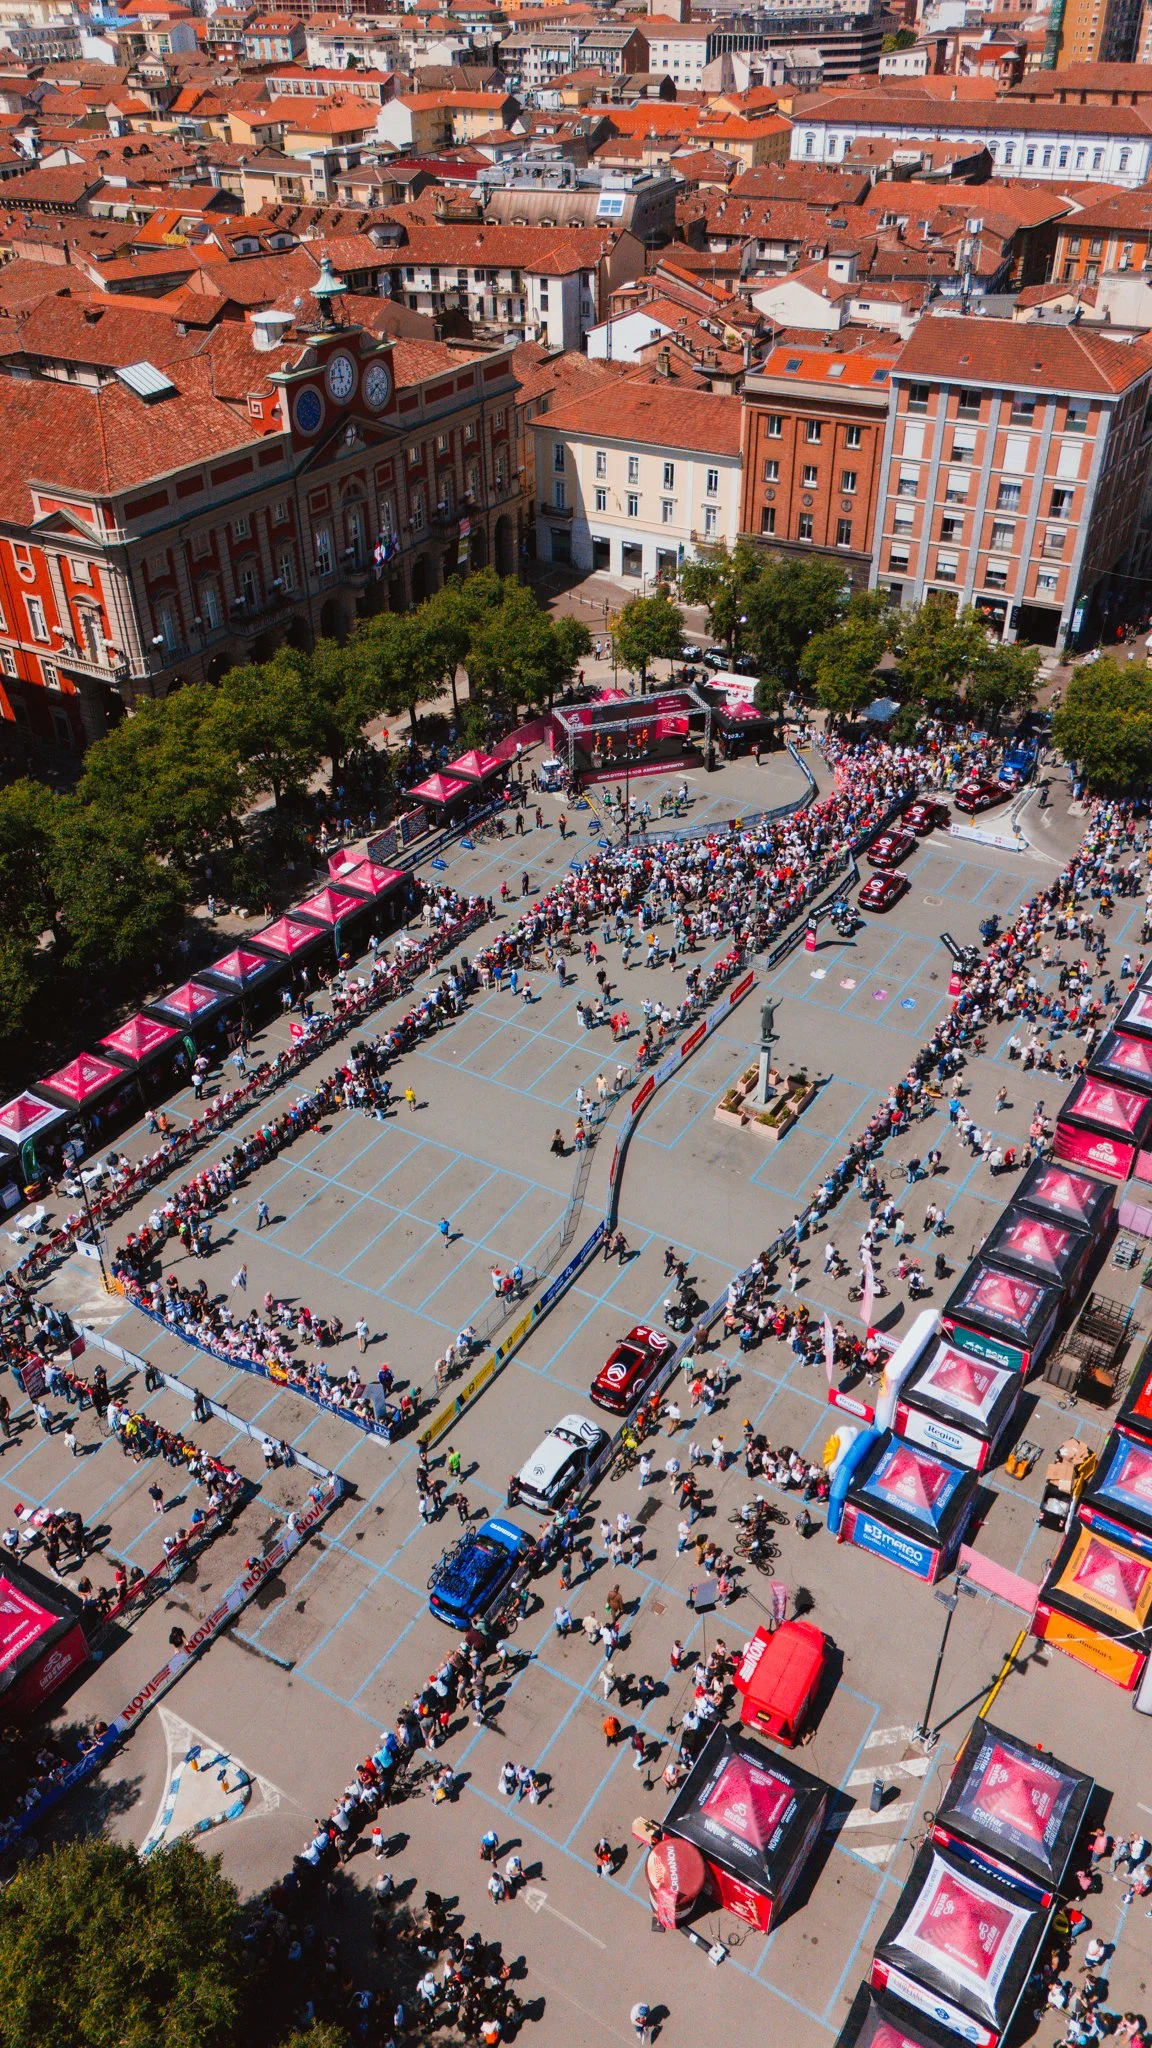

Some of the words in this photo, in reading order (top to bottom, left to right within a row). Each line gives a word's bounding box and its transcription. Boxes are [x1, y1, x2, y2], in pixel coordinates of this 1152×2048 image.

[610, 770, 632, 780] D'ITALA
[928, 1425, 960, 1445] Regina
[296, 1503, 325, 1536] NOVI
[242, 1558, 272, 1593] NOVI
[1082, 1592, 1113, 1612] Continental
[3, 1619, 30, 1644] #giroditalia
[184, 1621, 216, 1655] NOVI
[746, 1636, 768, 1666] NOVI
[51, 1653, 72, 1676] d'Italia
[122, 1684, 157, 1721] NOVI
[978, 1747, 993, 1772] Cetilar
[971, 1814, 1002, 1835] NUTRITION
[974, 1807, 1004, 1828] Cetilar
[1043, 1815, 1055, 1843] Cetilar
[767, 1832, 780, 1852] NOVI
[669, 1845, 679, 1892] CREMANOVI
